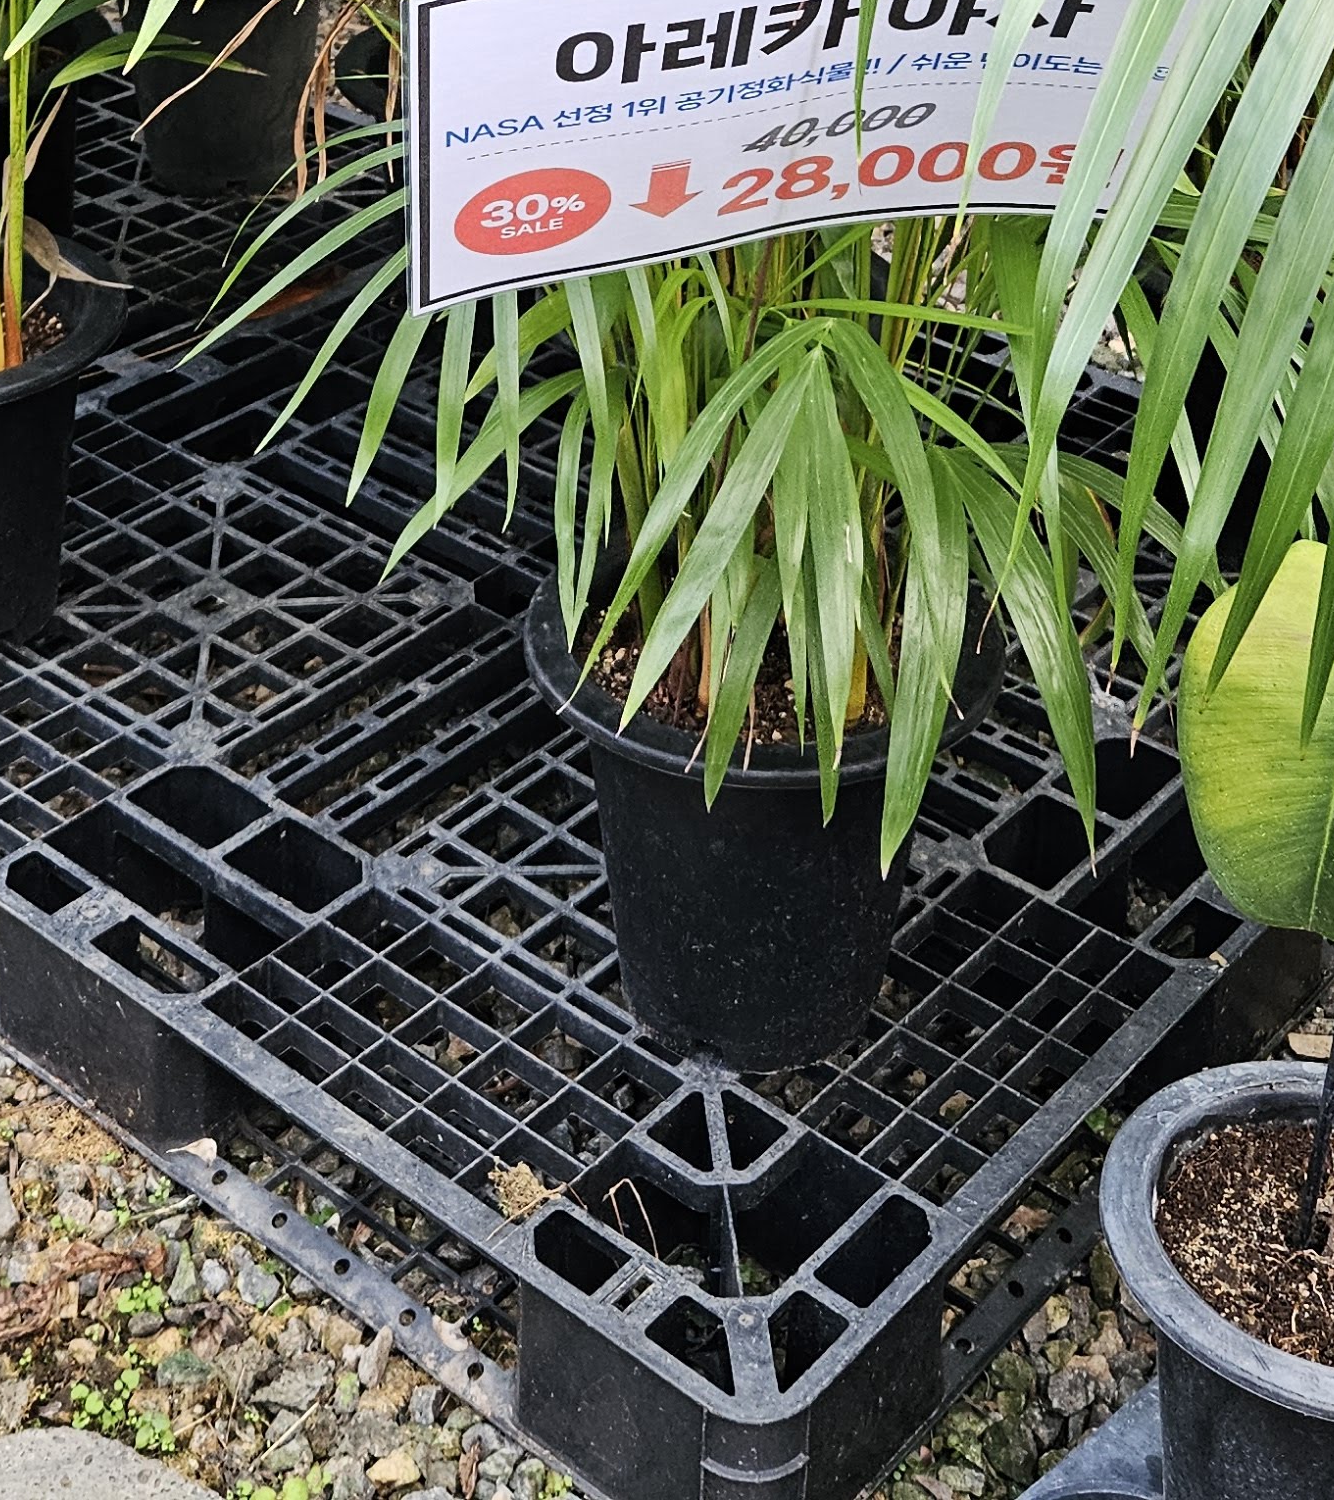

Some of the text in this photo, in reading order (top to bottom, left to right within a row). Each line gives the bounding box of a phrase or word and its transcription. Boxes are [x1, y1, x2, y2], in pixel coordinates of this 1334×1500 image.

[445, 115, 544, 147] NASA
[553, 103, 613, 128] 선정
[622, 96, 666, 117] 1위
[910, 52, 973, 71] 쉬운
[980, 52, 1104, 75] 이도는
[741, 102, 937, 152] 40,000
[480, 193, 586, 228] 30%
[500, 217, 564, 239] SALE
